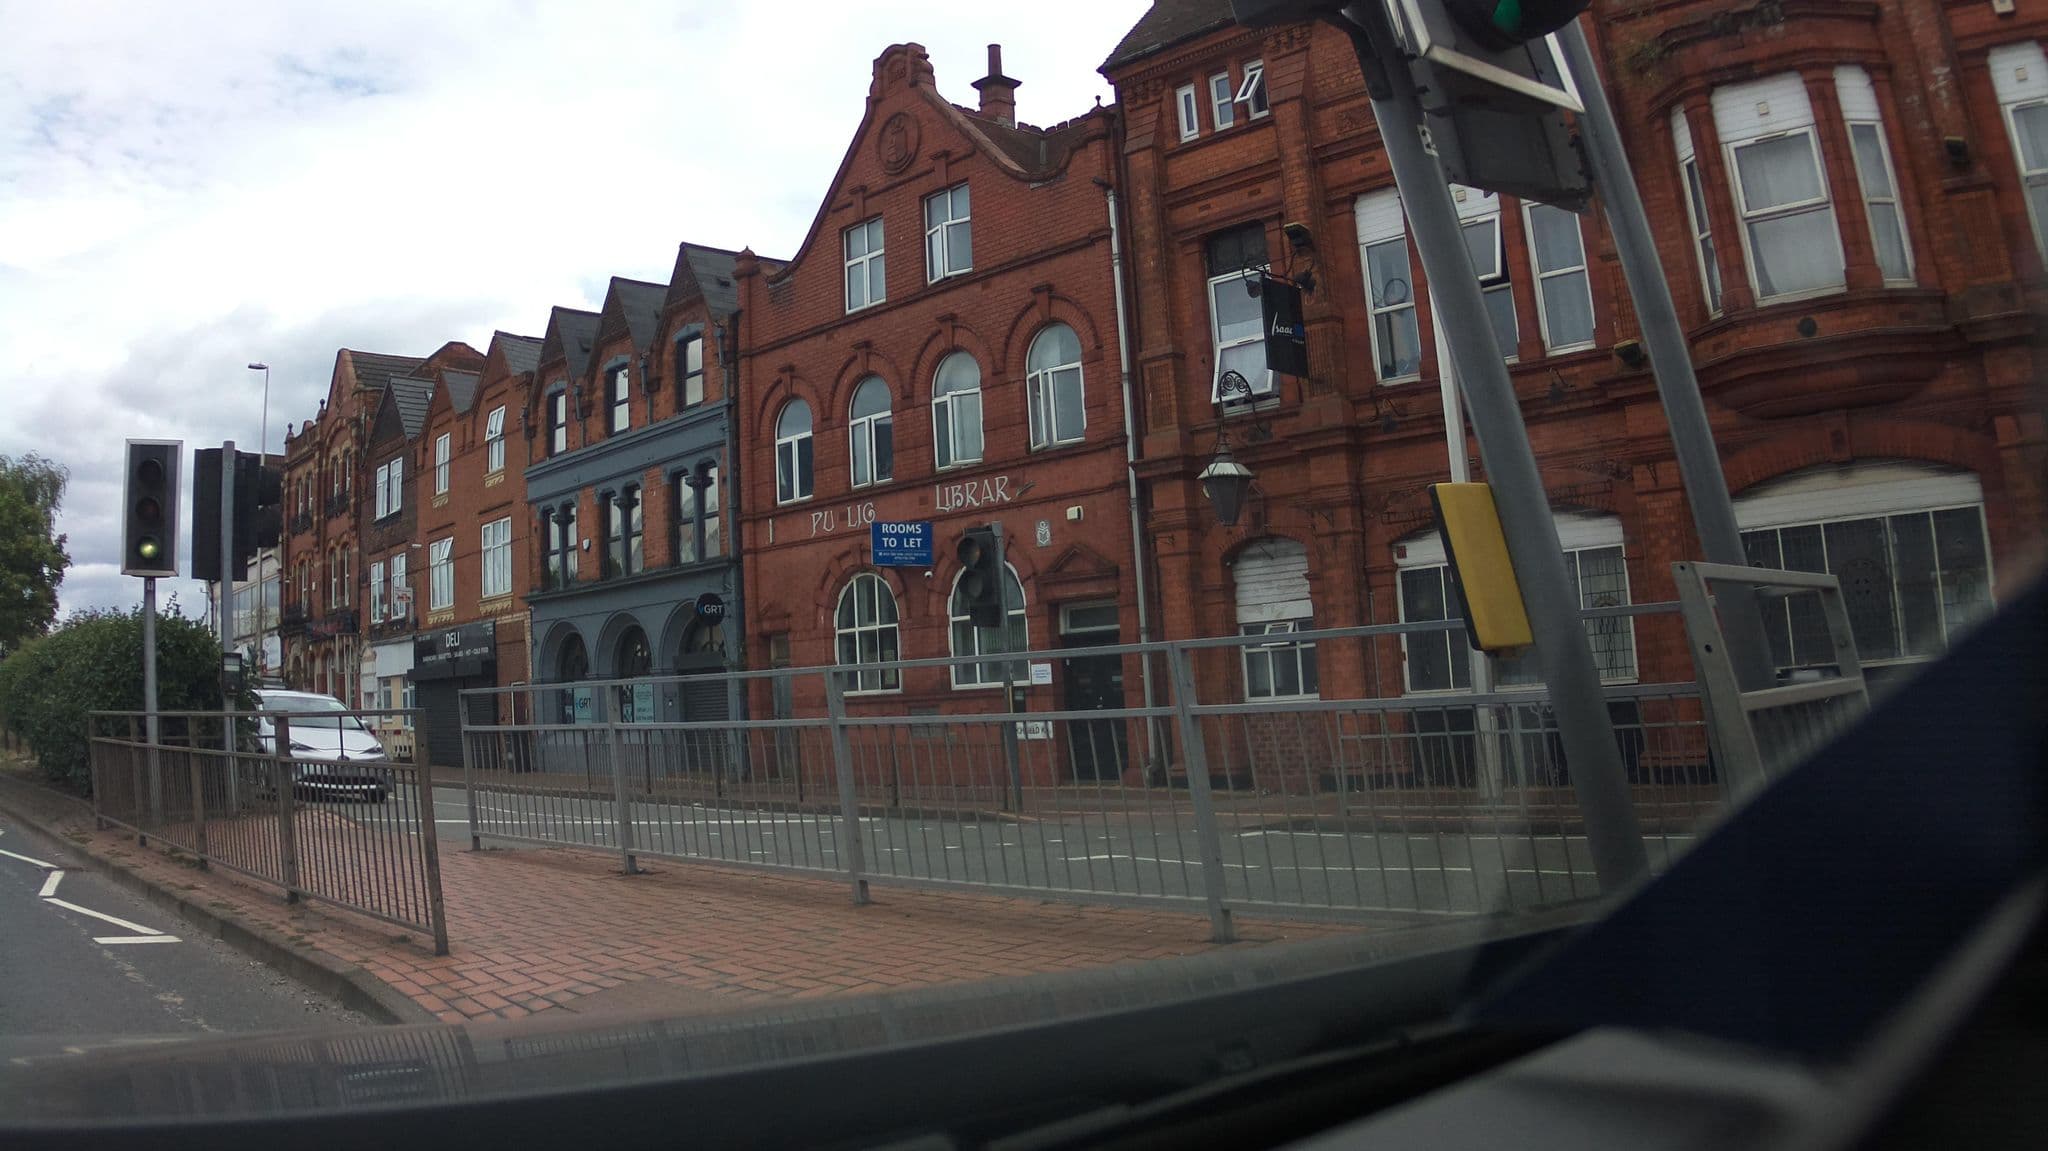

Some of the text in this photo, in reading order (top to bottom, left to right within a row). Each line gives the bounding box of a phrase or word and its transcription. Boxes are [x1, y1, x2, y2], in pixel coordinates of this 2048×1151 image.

[882, 523, 922, 534] ROOMS
[882, 537, 923, 548] TO LET
[704, 604, 723, 614] GRT
[445, 631, 460, 648] DELI
